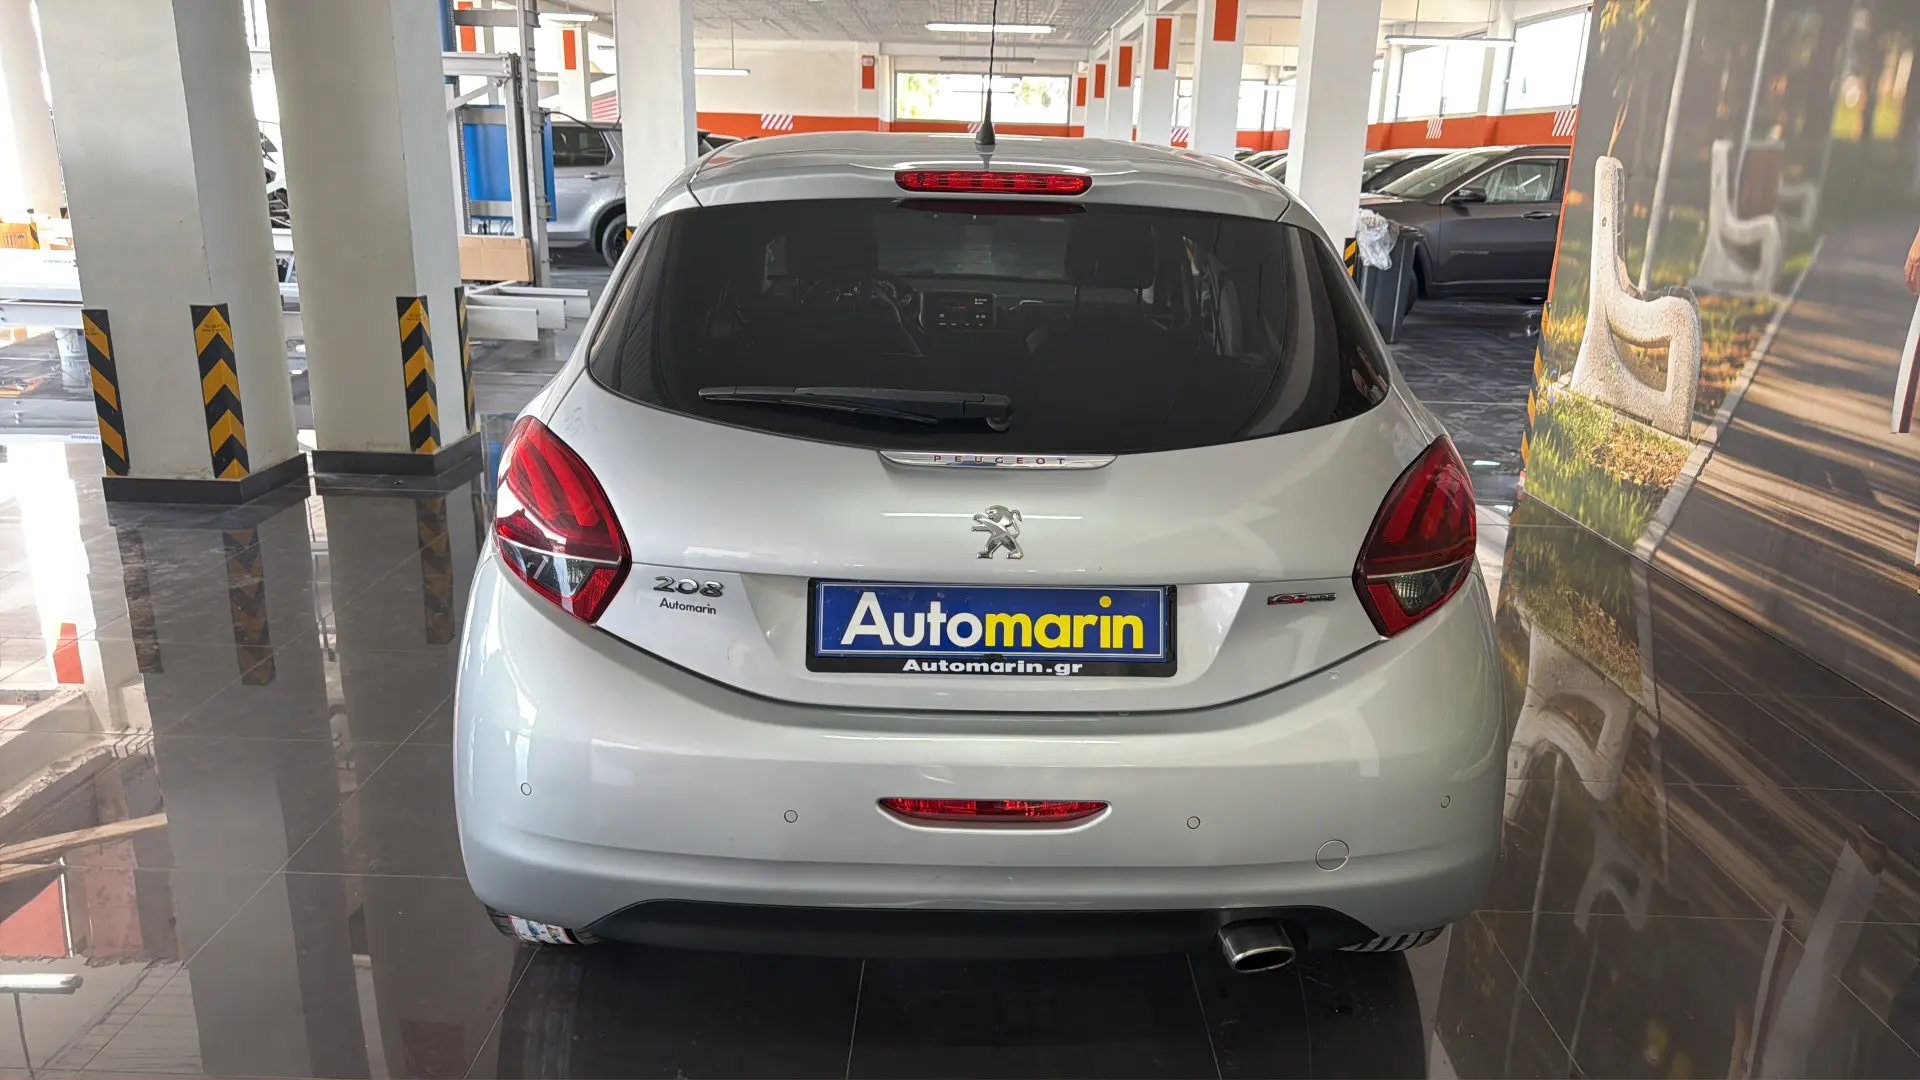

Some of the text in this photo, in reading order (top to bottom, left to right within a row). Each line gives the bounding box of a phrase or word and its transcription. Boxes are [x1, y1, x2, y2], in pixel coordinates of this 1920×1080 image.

[933, 455, 1066, 465] PEUGEOT
[653, 576, 724, 598] 208
[660, 597, 717, 615] Automarin
[840, 591, 1144, 649] Automarin
[902, 658, 1083, 676] Automarin.gr
